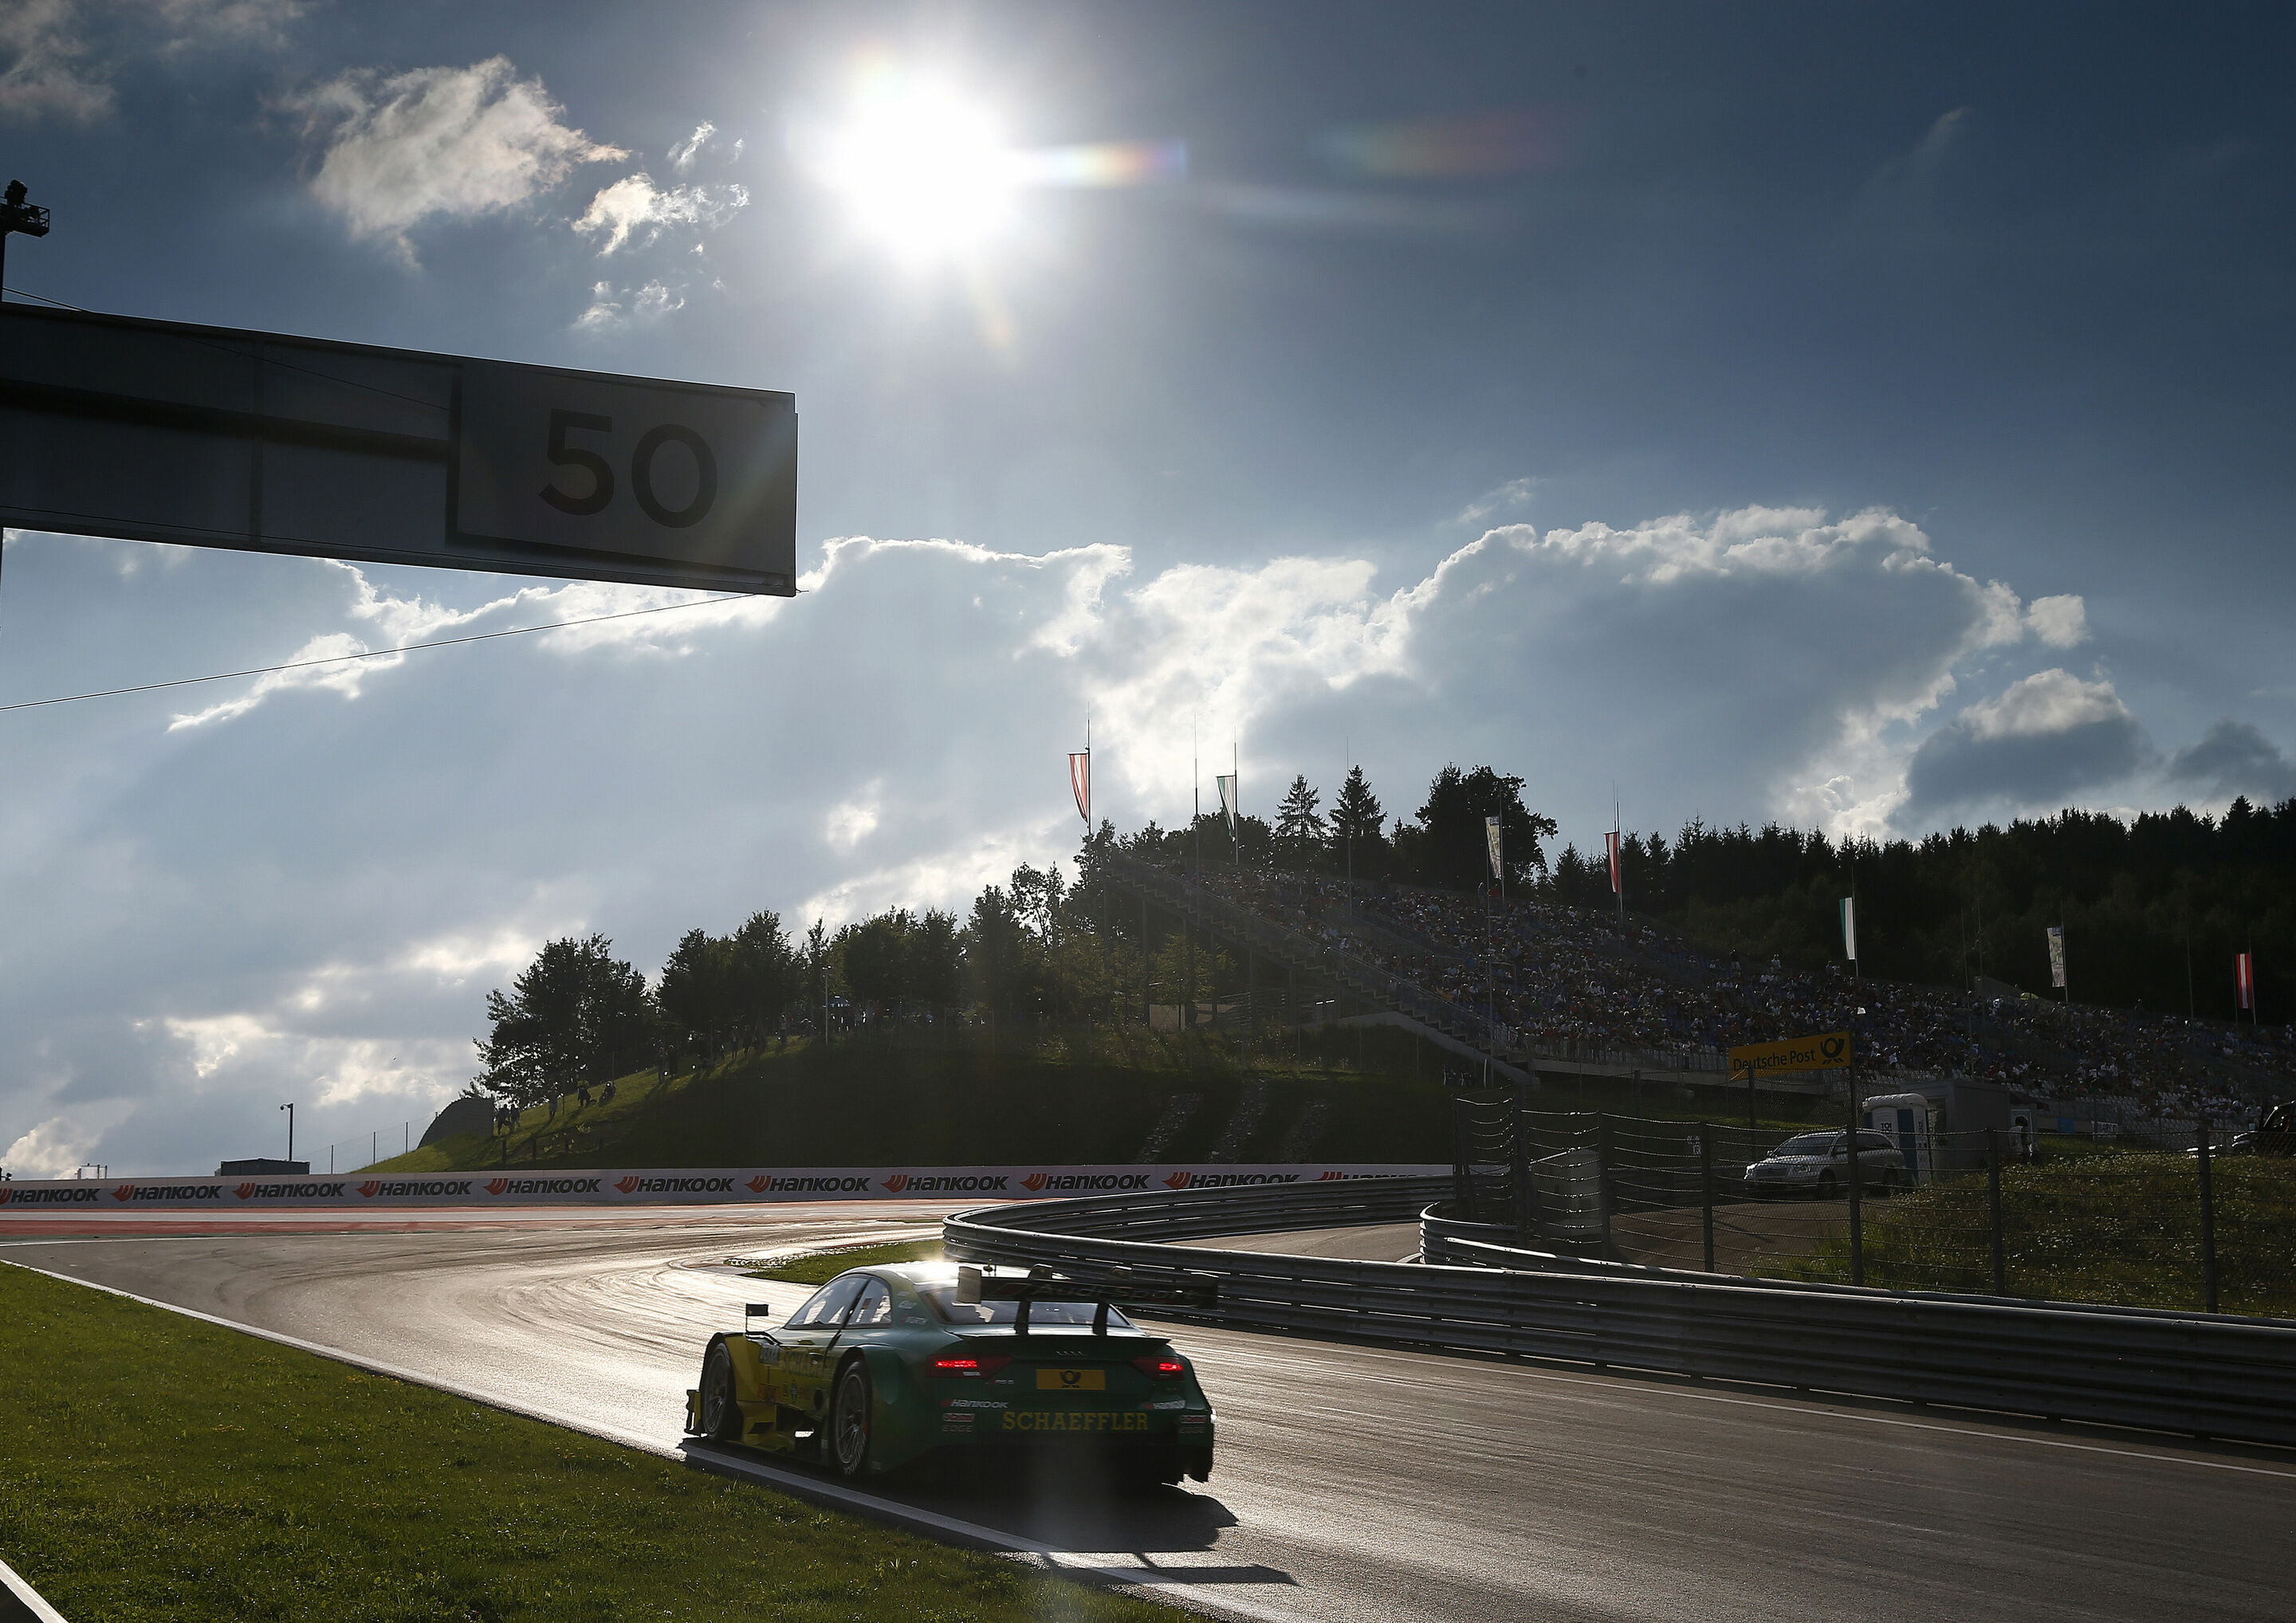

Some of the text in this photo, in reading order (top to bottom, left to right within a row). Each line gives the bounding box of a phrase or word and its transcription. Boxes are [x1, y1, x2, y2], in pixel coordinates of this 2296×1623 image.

[540, 407, 718, 529] 50
[1733, 1049, 1816, 1071] Deutsche Post
[1002, 1411, 1149, 1430] SCHAEFFLER
